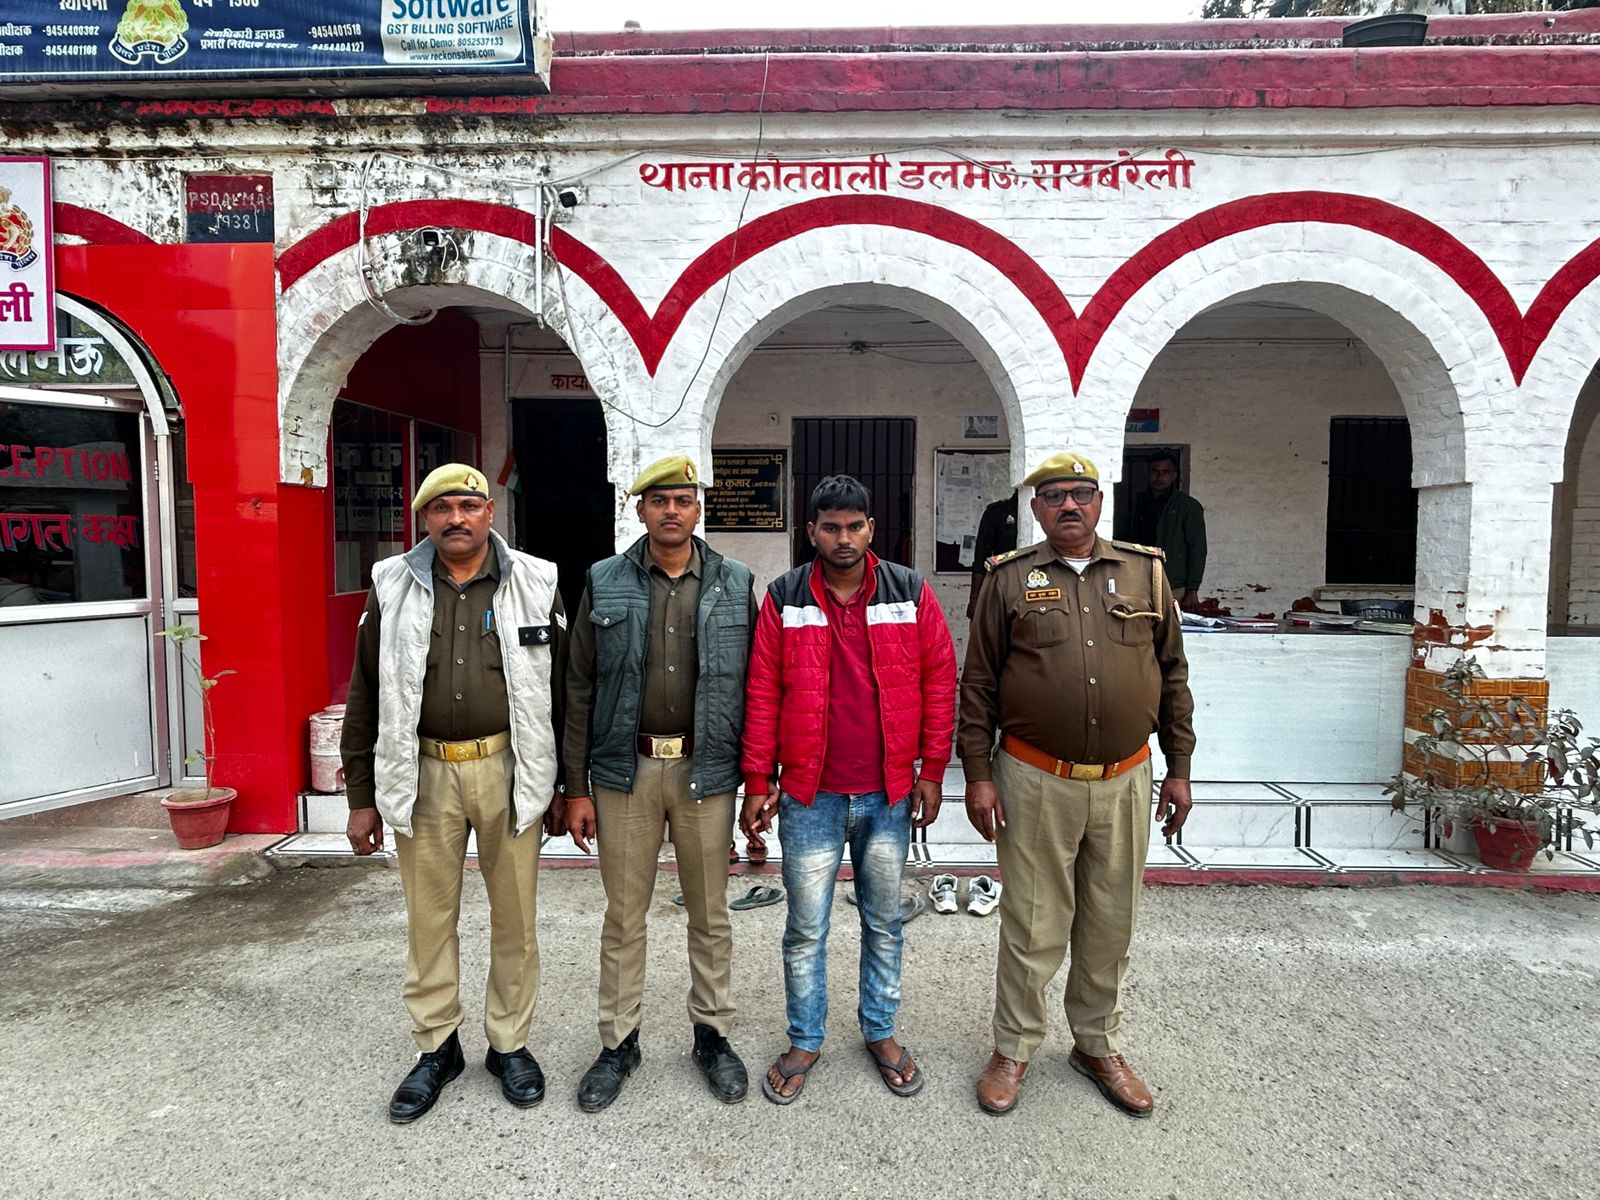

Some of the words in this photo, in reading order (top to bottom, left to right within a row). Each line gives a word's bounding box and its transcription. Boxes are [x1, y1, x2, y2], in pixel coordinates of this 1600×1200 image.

[386, 24, 408, 35] GST
[411, 23, 454, 34] BILLING
[457, 15, 514, 34] SOFTWARE
[400, 40, 416, 51] Call
[417, 38, 429, 50] for
[430, 38, 456, 49] Demo:
[638, 163, 734, 192] थाना
[736, 153, 892, 192] कोतवाली
[1030, 149, 1196, 192] रायबरेली
